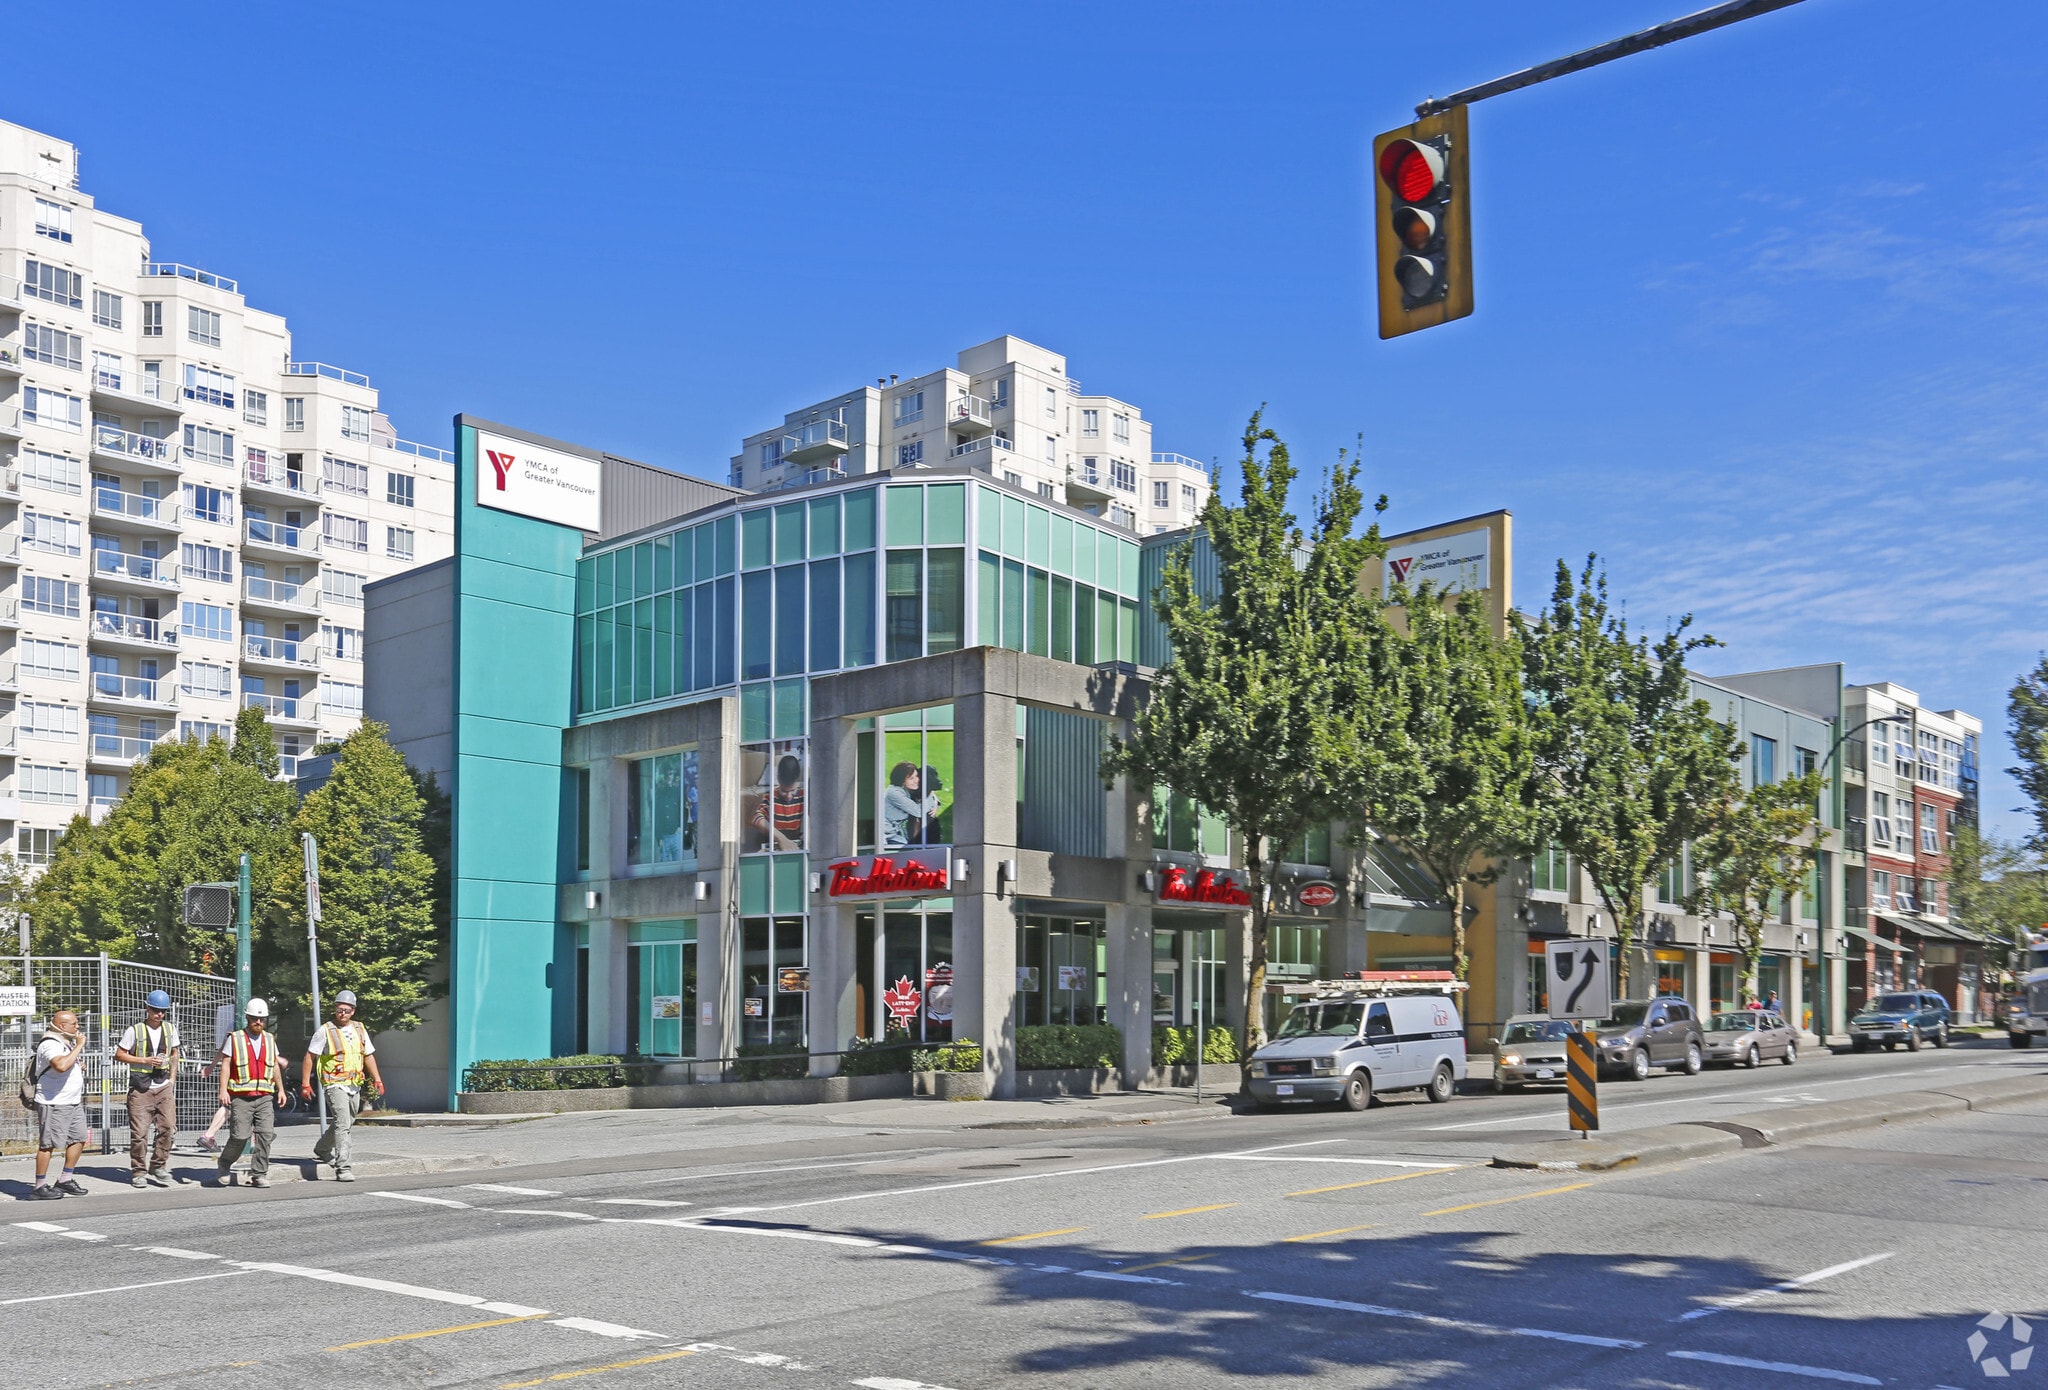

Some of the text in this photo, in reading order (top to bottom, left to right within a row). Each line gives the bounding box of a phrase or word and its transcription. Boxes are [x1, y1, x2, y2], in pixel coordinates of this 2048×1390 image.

[524, 459, 559, 475] YMCA of
[524, 470, 596, 496] Greater Vancouver
[1441, 549, 1451, 557] of
[1420, 561, 1447, 572] Greater
[828, 861, 868, 896] Tim
